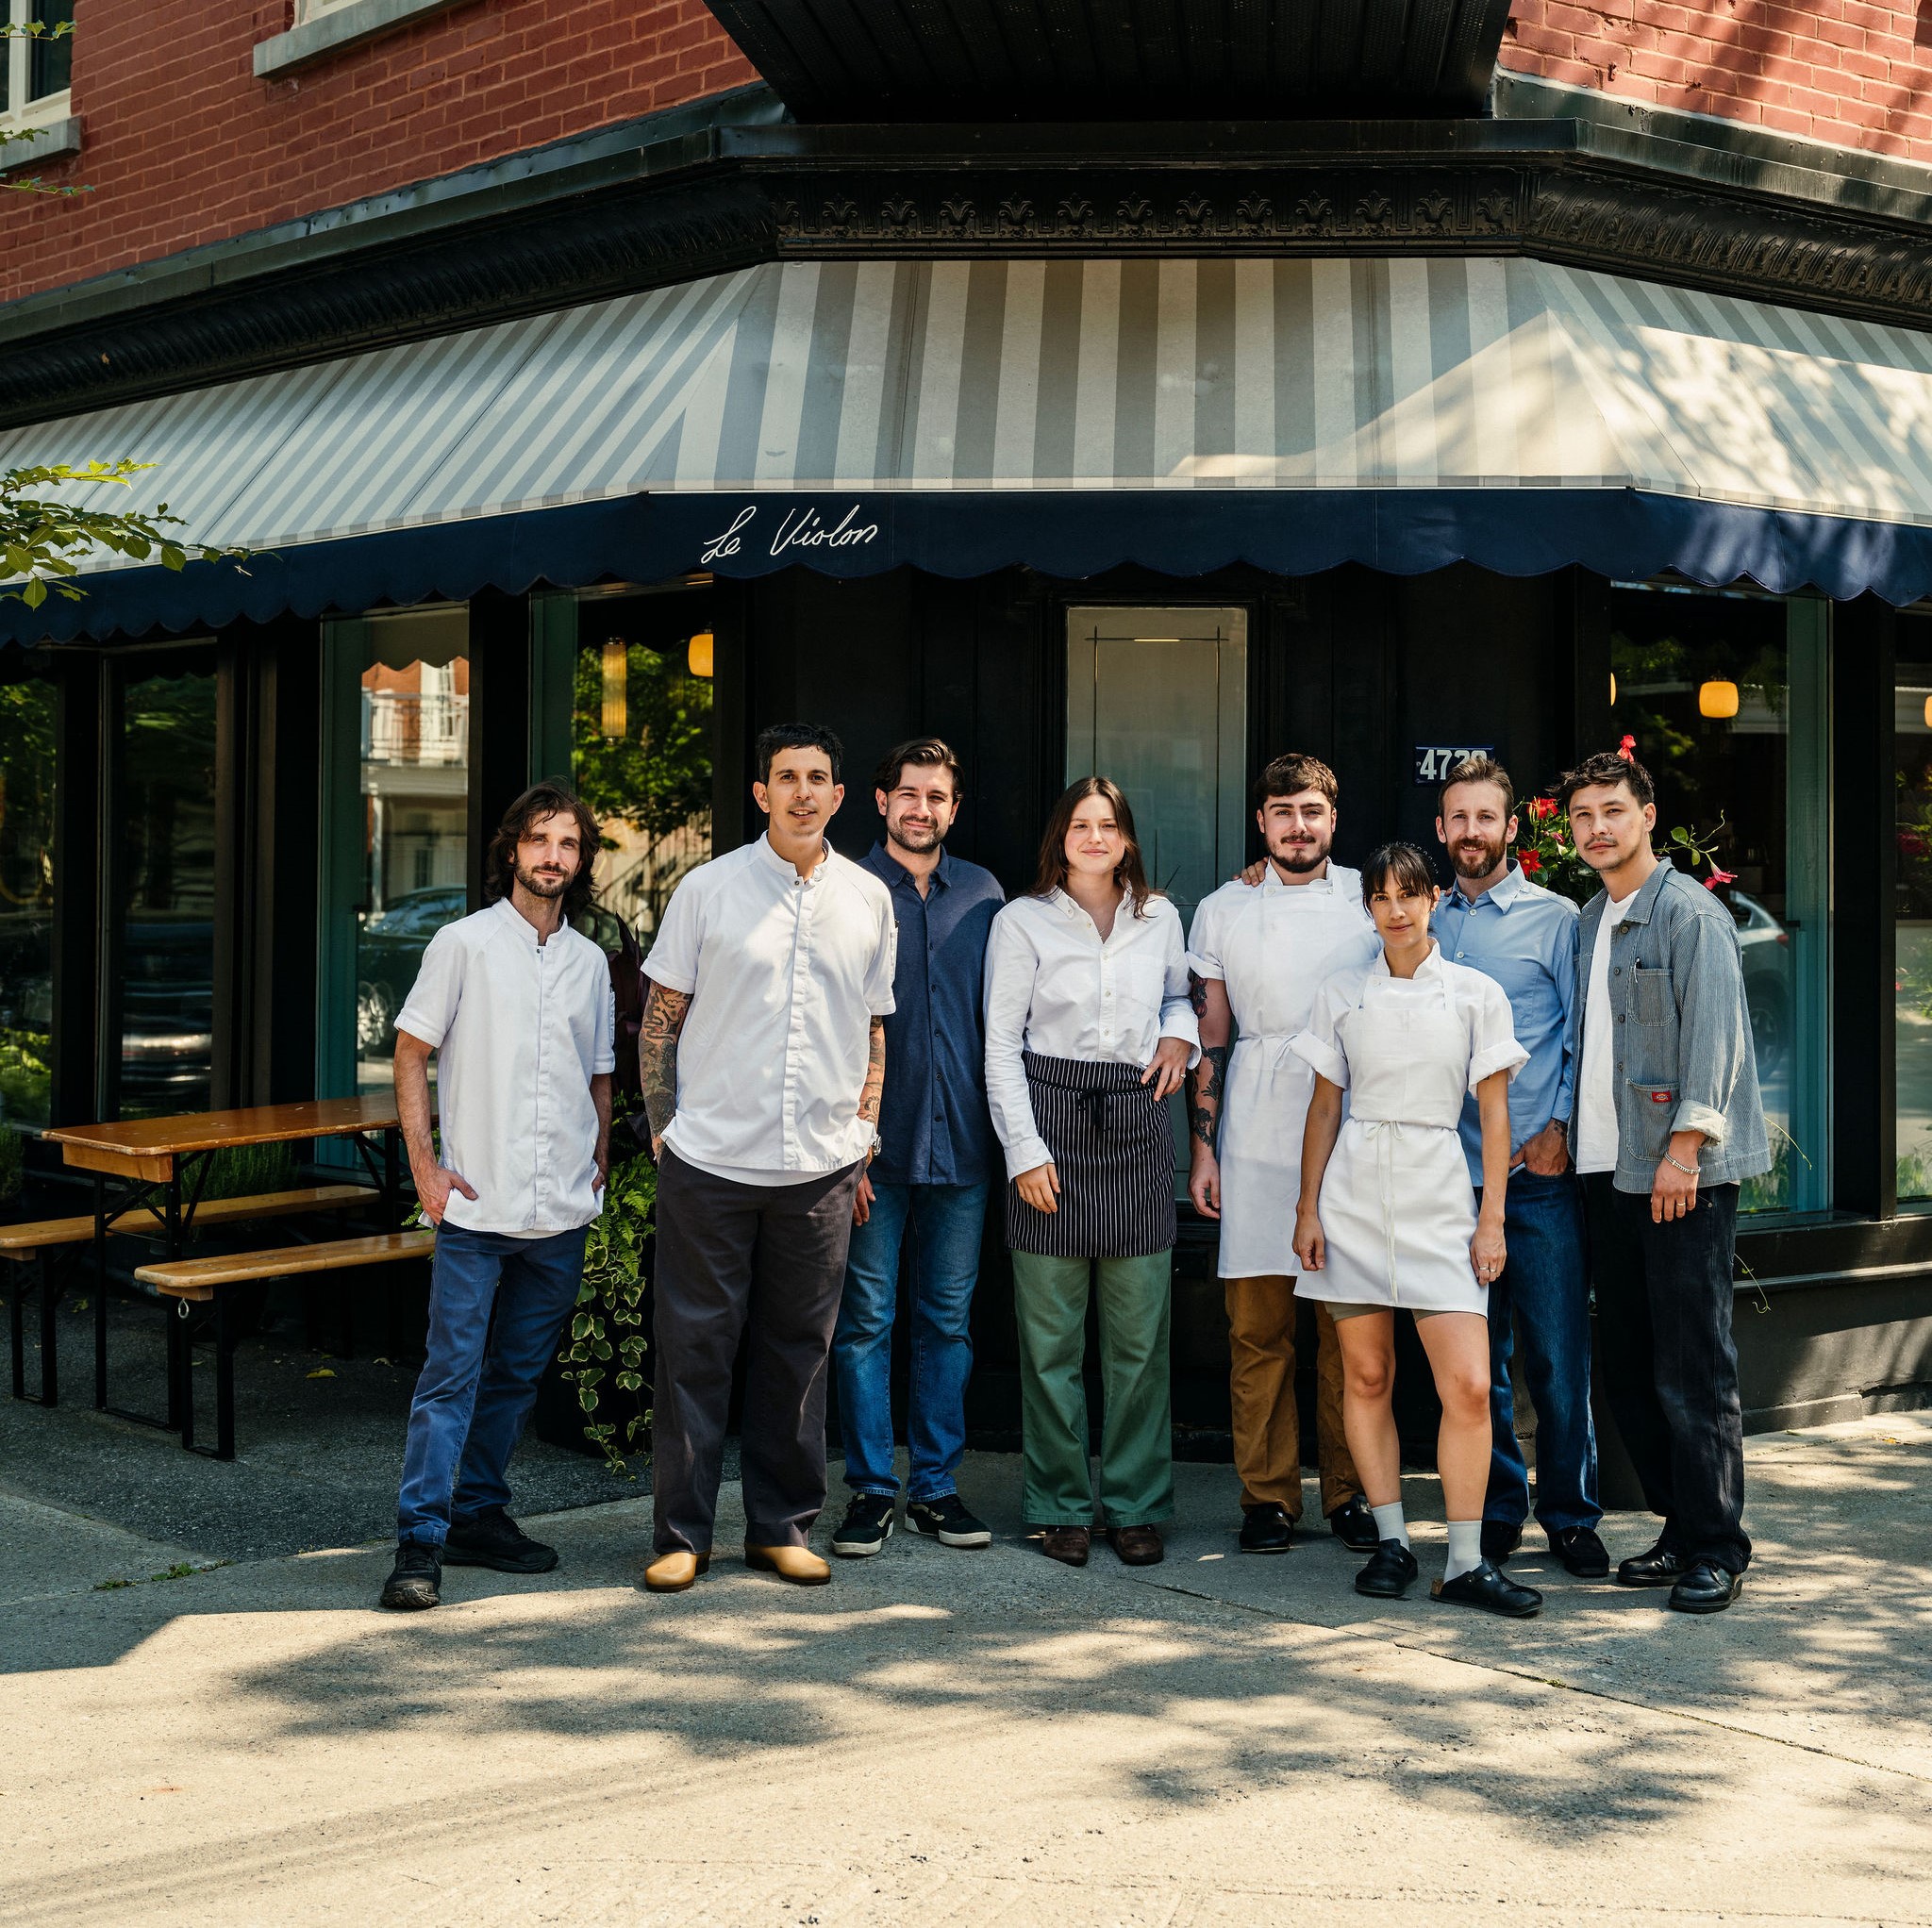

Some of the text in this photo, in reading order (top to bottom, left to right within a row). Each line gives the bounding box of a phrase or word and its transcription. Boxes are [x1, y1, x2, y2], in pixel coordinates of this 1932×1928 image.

[701, 505, 878, 564] Le Violon
[1419, 749, 1488, 780] 472
